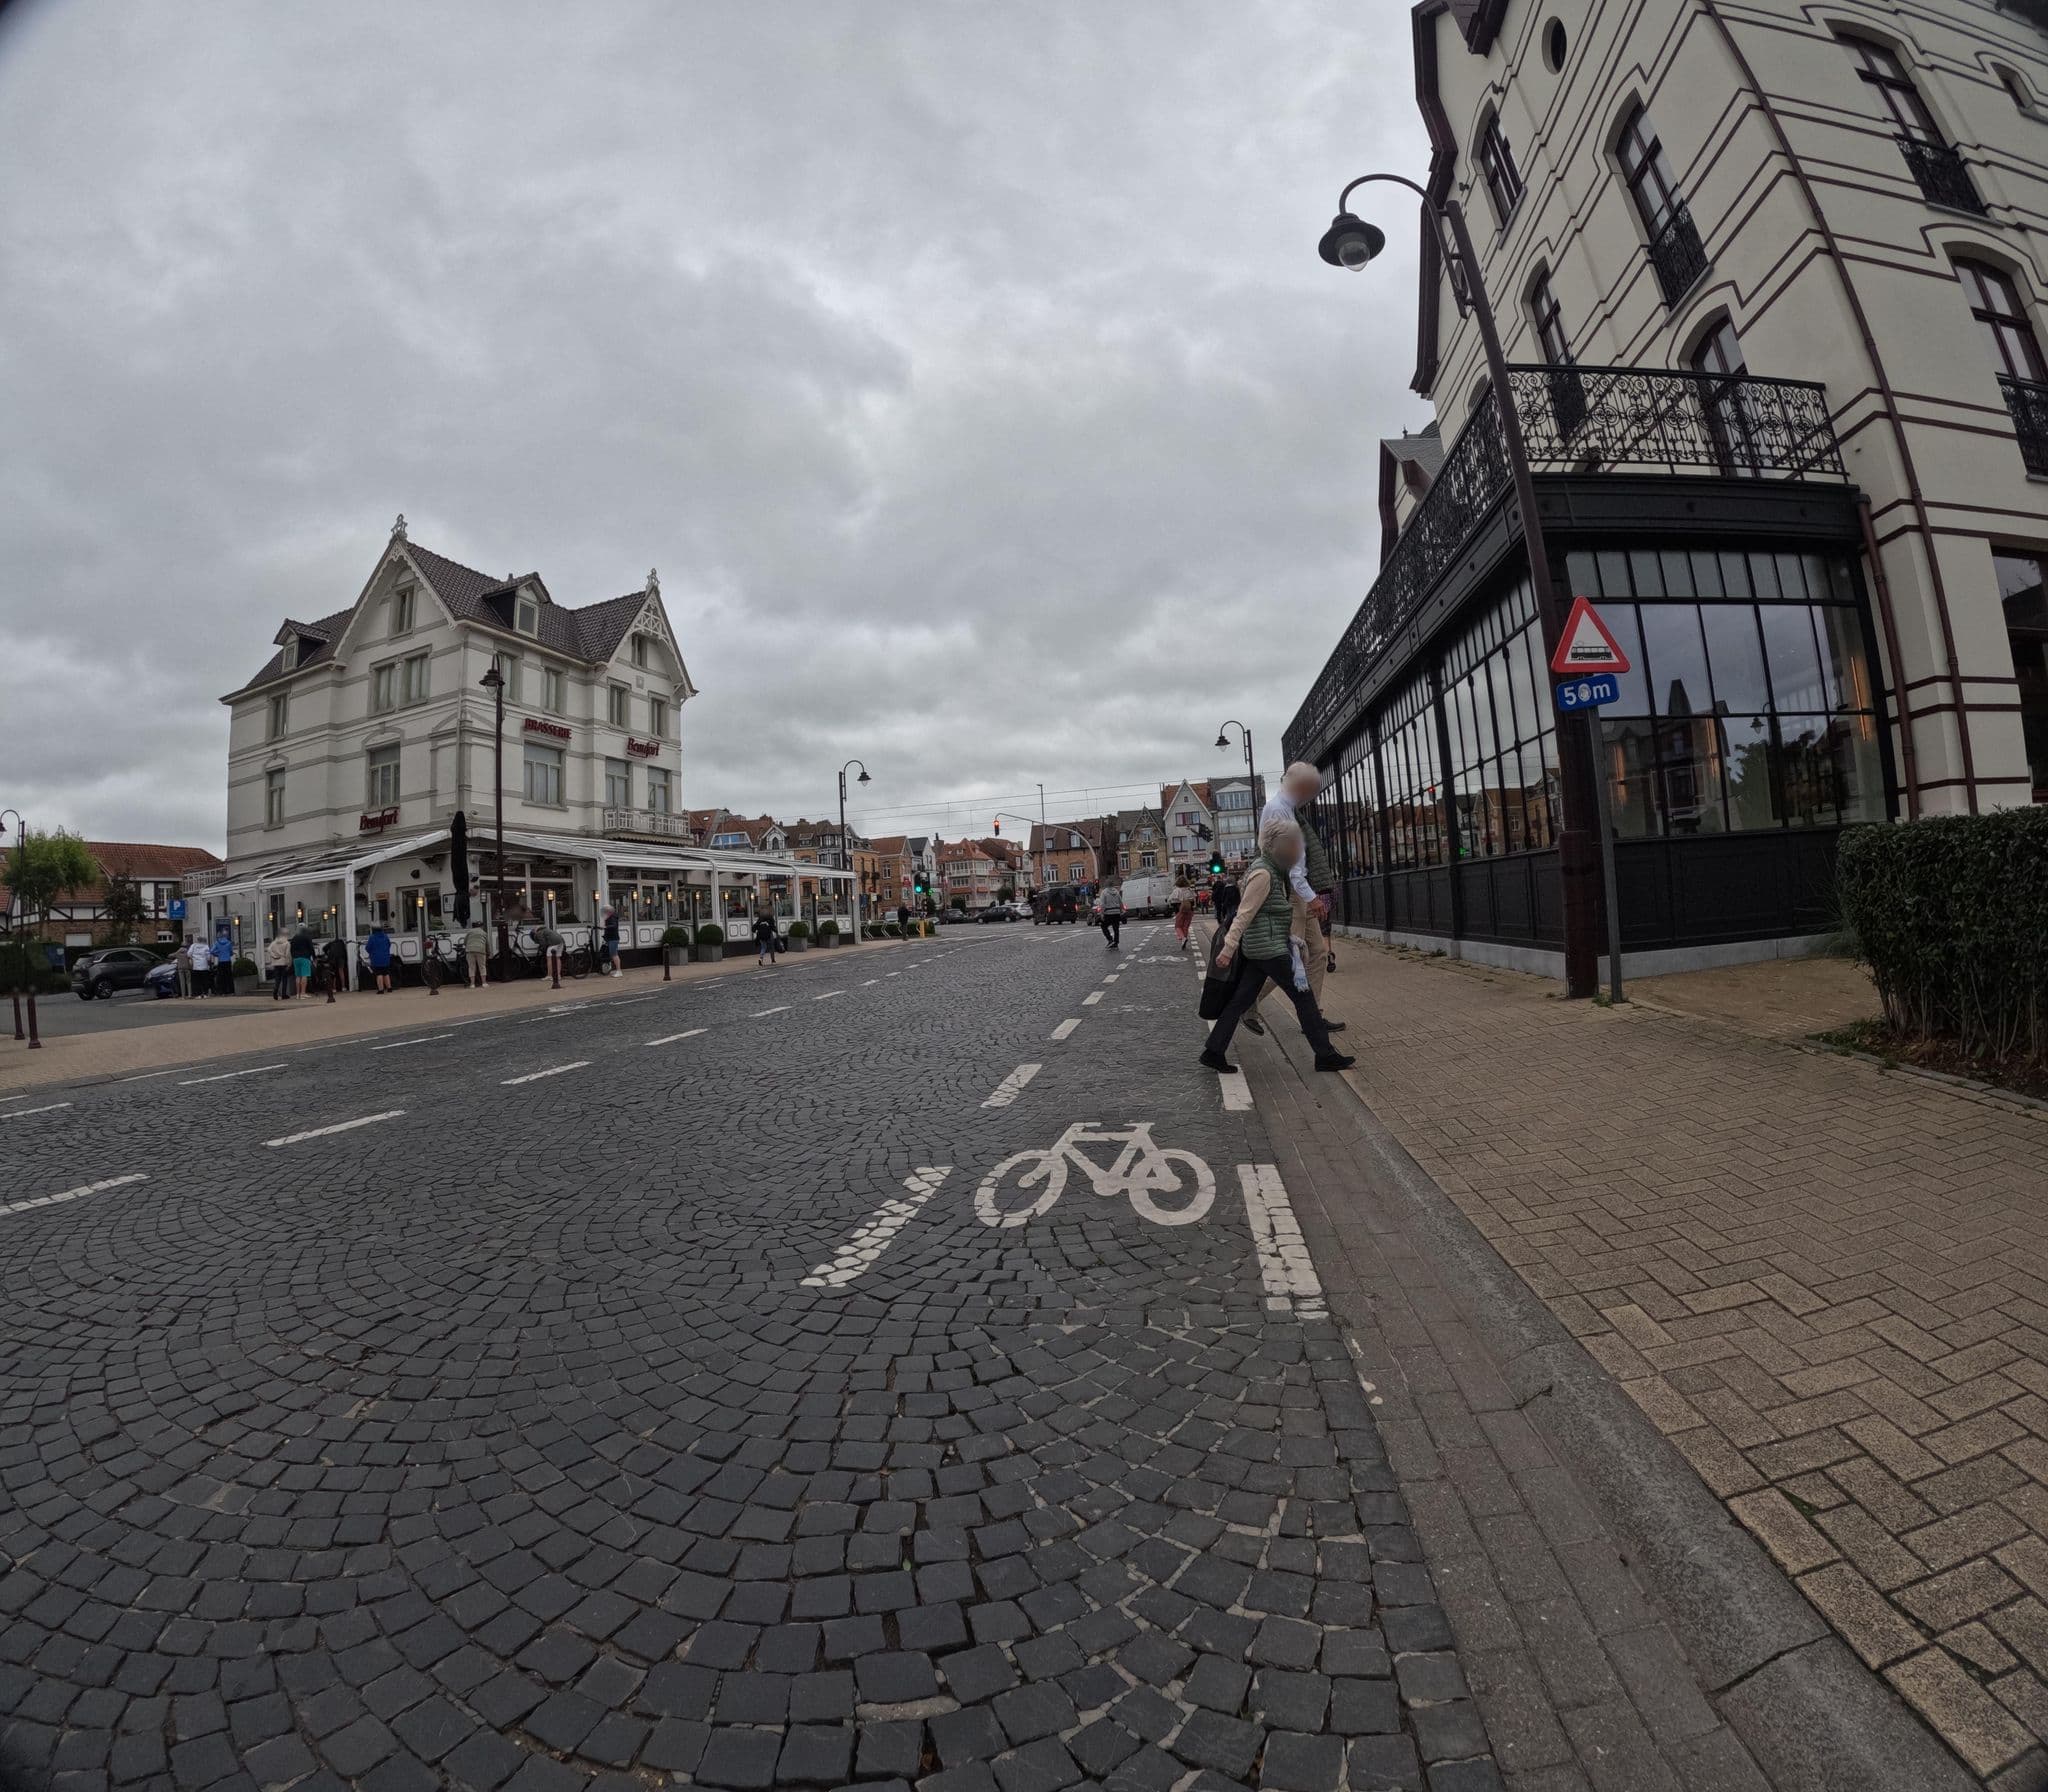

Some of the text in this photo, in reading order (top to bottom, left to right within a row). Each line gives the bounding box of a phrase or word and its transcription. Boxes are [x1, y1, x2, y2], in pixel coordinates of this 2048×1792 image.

[1564, 683, 1611, 706] 50m
[525, 718, 572, 740] BRASSERIE
[627, 736, 660, 759] Beaufort
[359, 806, 400, 833] Beaufort
[173, 900, 181, 911] P
